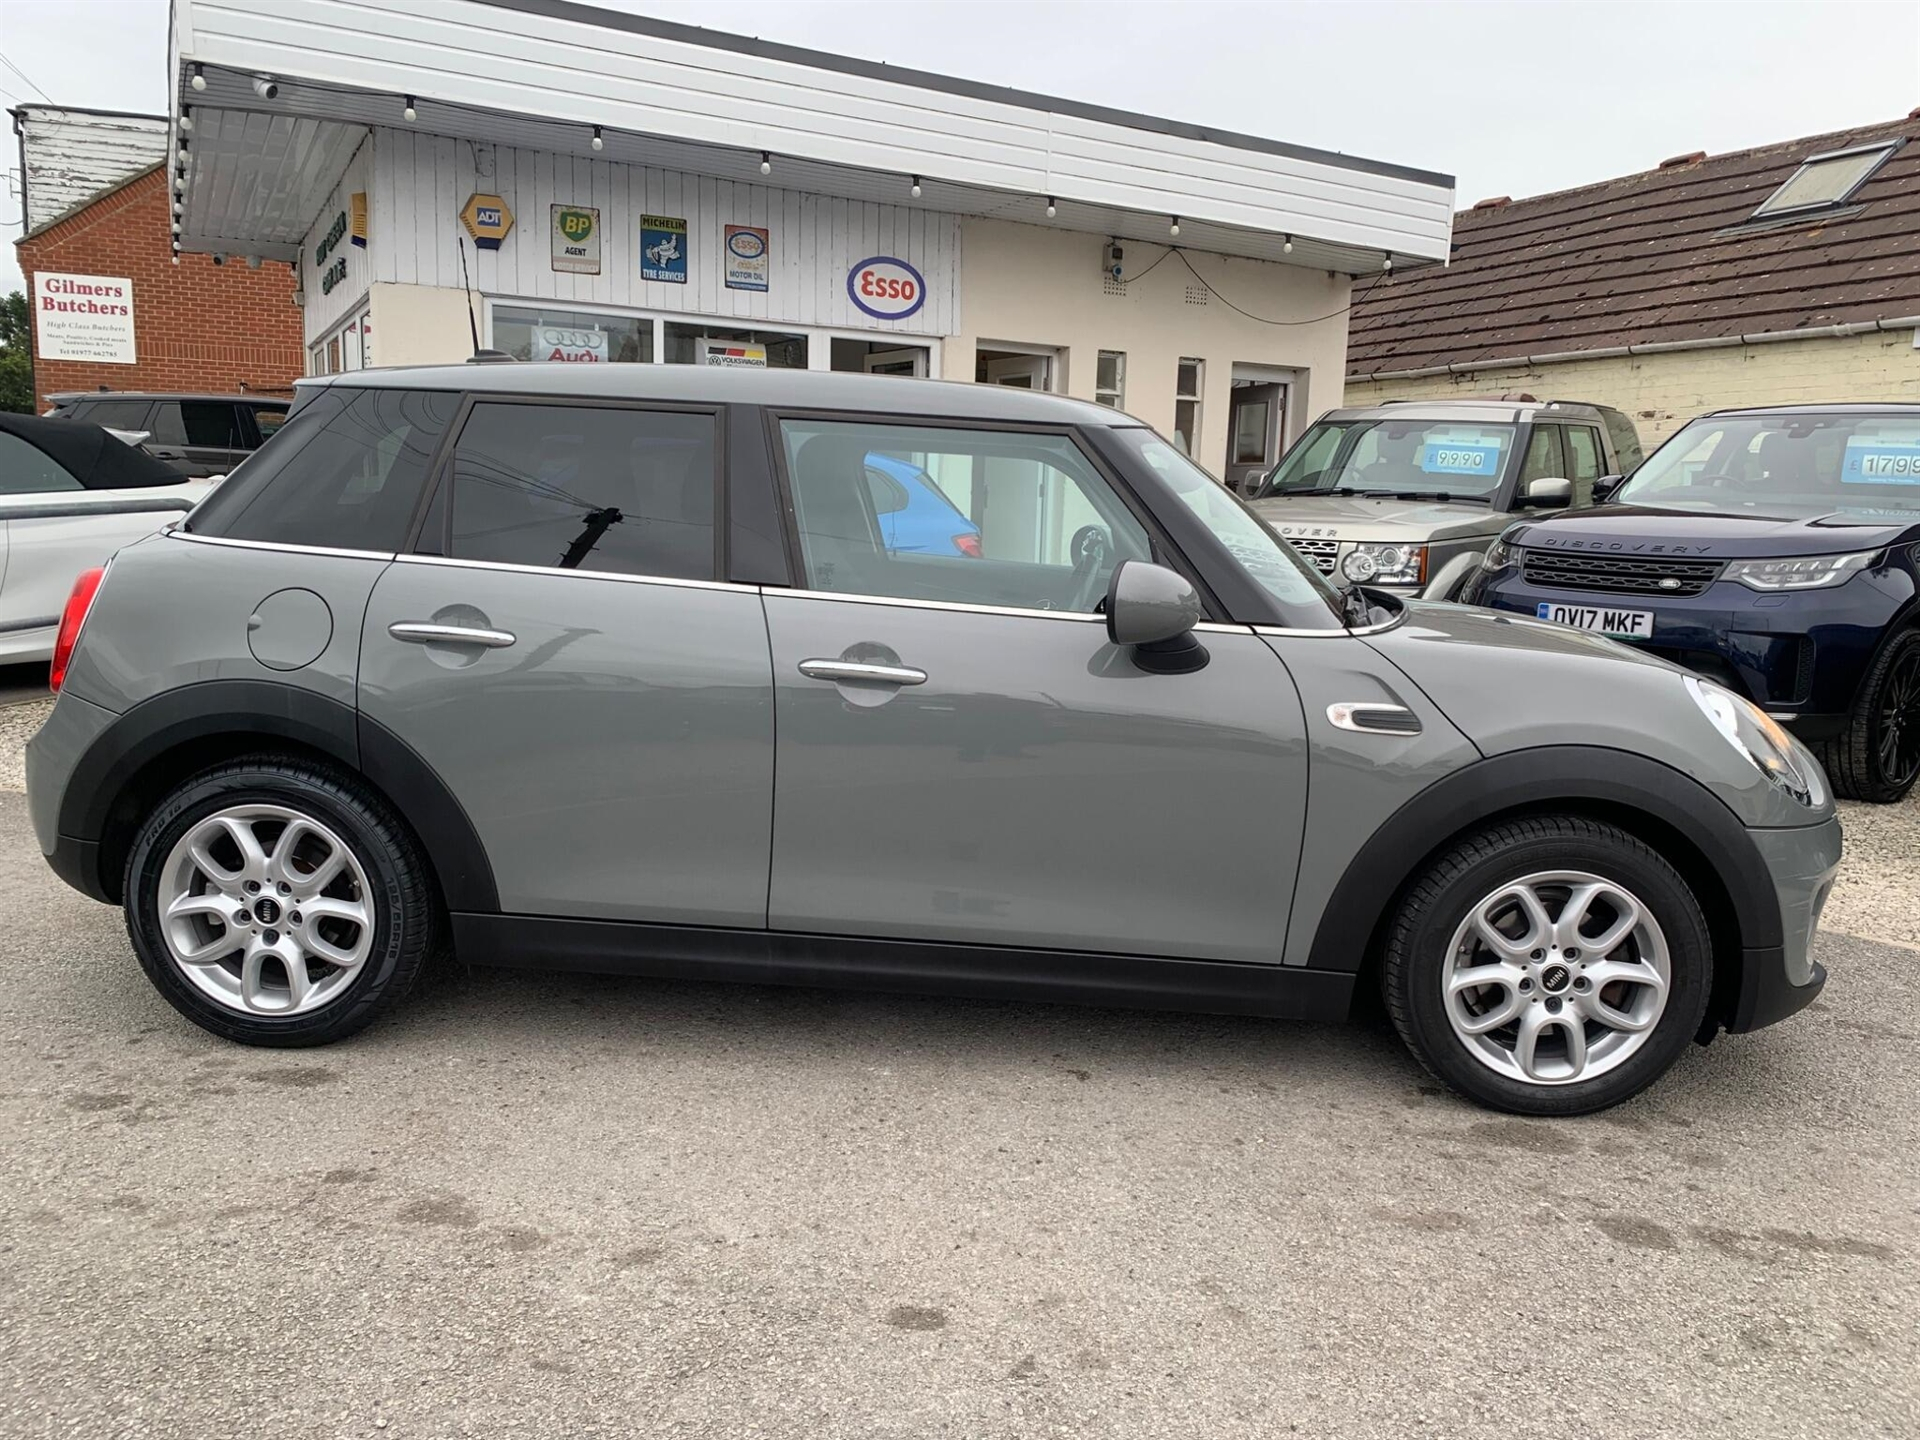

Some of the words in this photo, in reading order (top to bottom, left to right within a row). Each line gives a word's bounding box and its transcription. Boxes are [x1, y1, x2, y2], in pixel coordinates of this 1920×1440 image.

[477, 211, 501, 223] ADT
[565, 216, 590, 233] BP
[642, 217, 685, 230] MICHELIN
[564, 246, 587, 256] AGENT
[643, 268, 657, 279] TYRE
[658, 270, 685, 281] SERVICES
[730, 270, 752, 279] MOTOR
[45, 278, 123, 298] Gilmers
[41, 296, 128, 316] Butchers
[46, 321, 66, 329] High
[68, 322, 90, 330] Class
[92, 323, 126, 332] Butchers
[548, 347, 599, 362] Audi
[721, 356, 765, 366] VOLKSWAGEN
[1439, 451, 1483, 467] 9990
[1278, 527, 1338, 537] OVER
[1545, 538, 1712, 554] DISCOVERY
[1554, 607, 1598, 629] OV17
[1602, 611, 1645, 633] MKF
[262, 900, 271, 921] MINI
[1546, 969, 1566, 988] MINI
